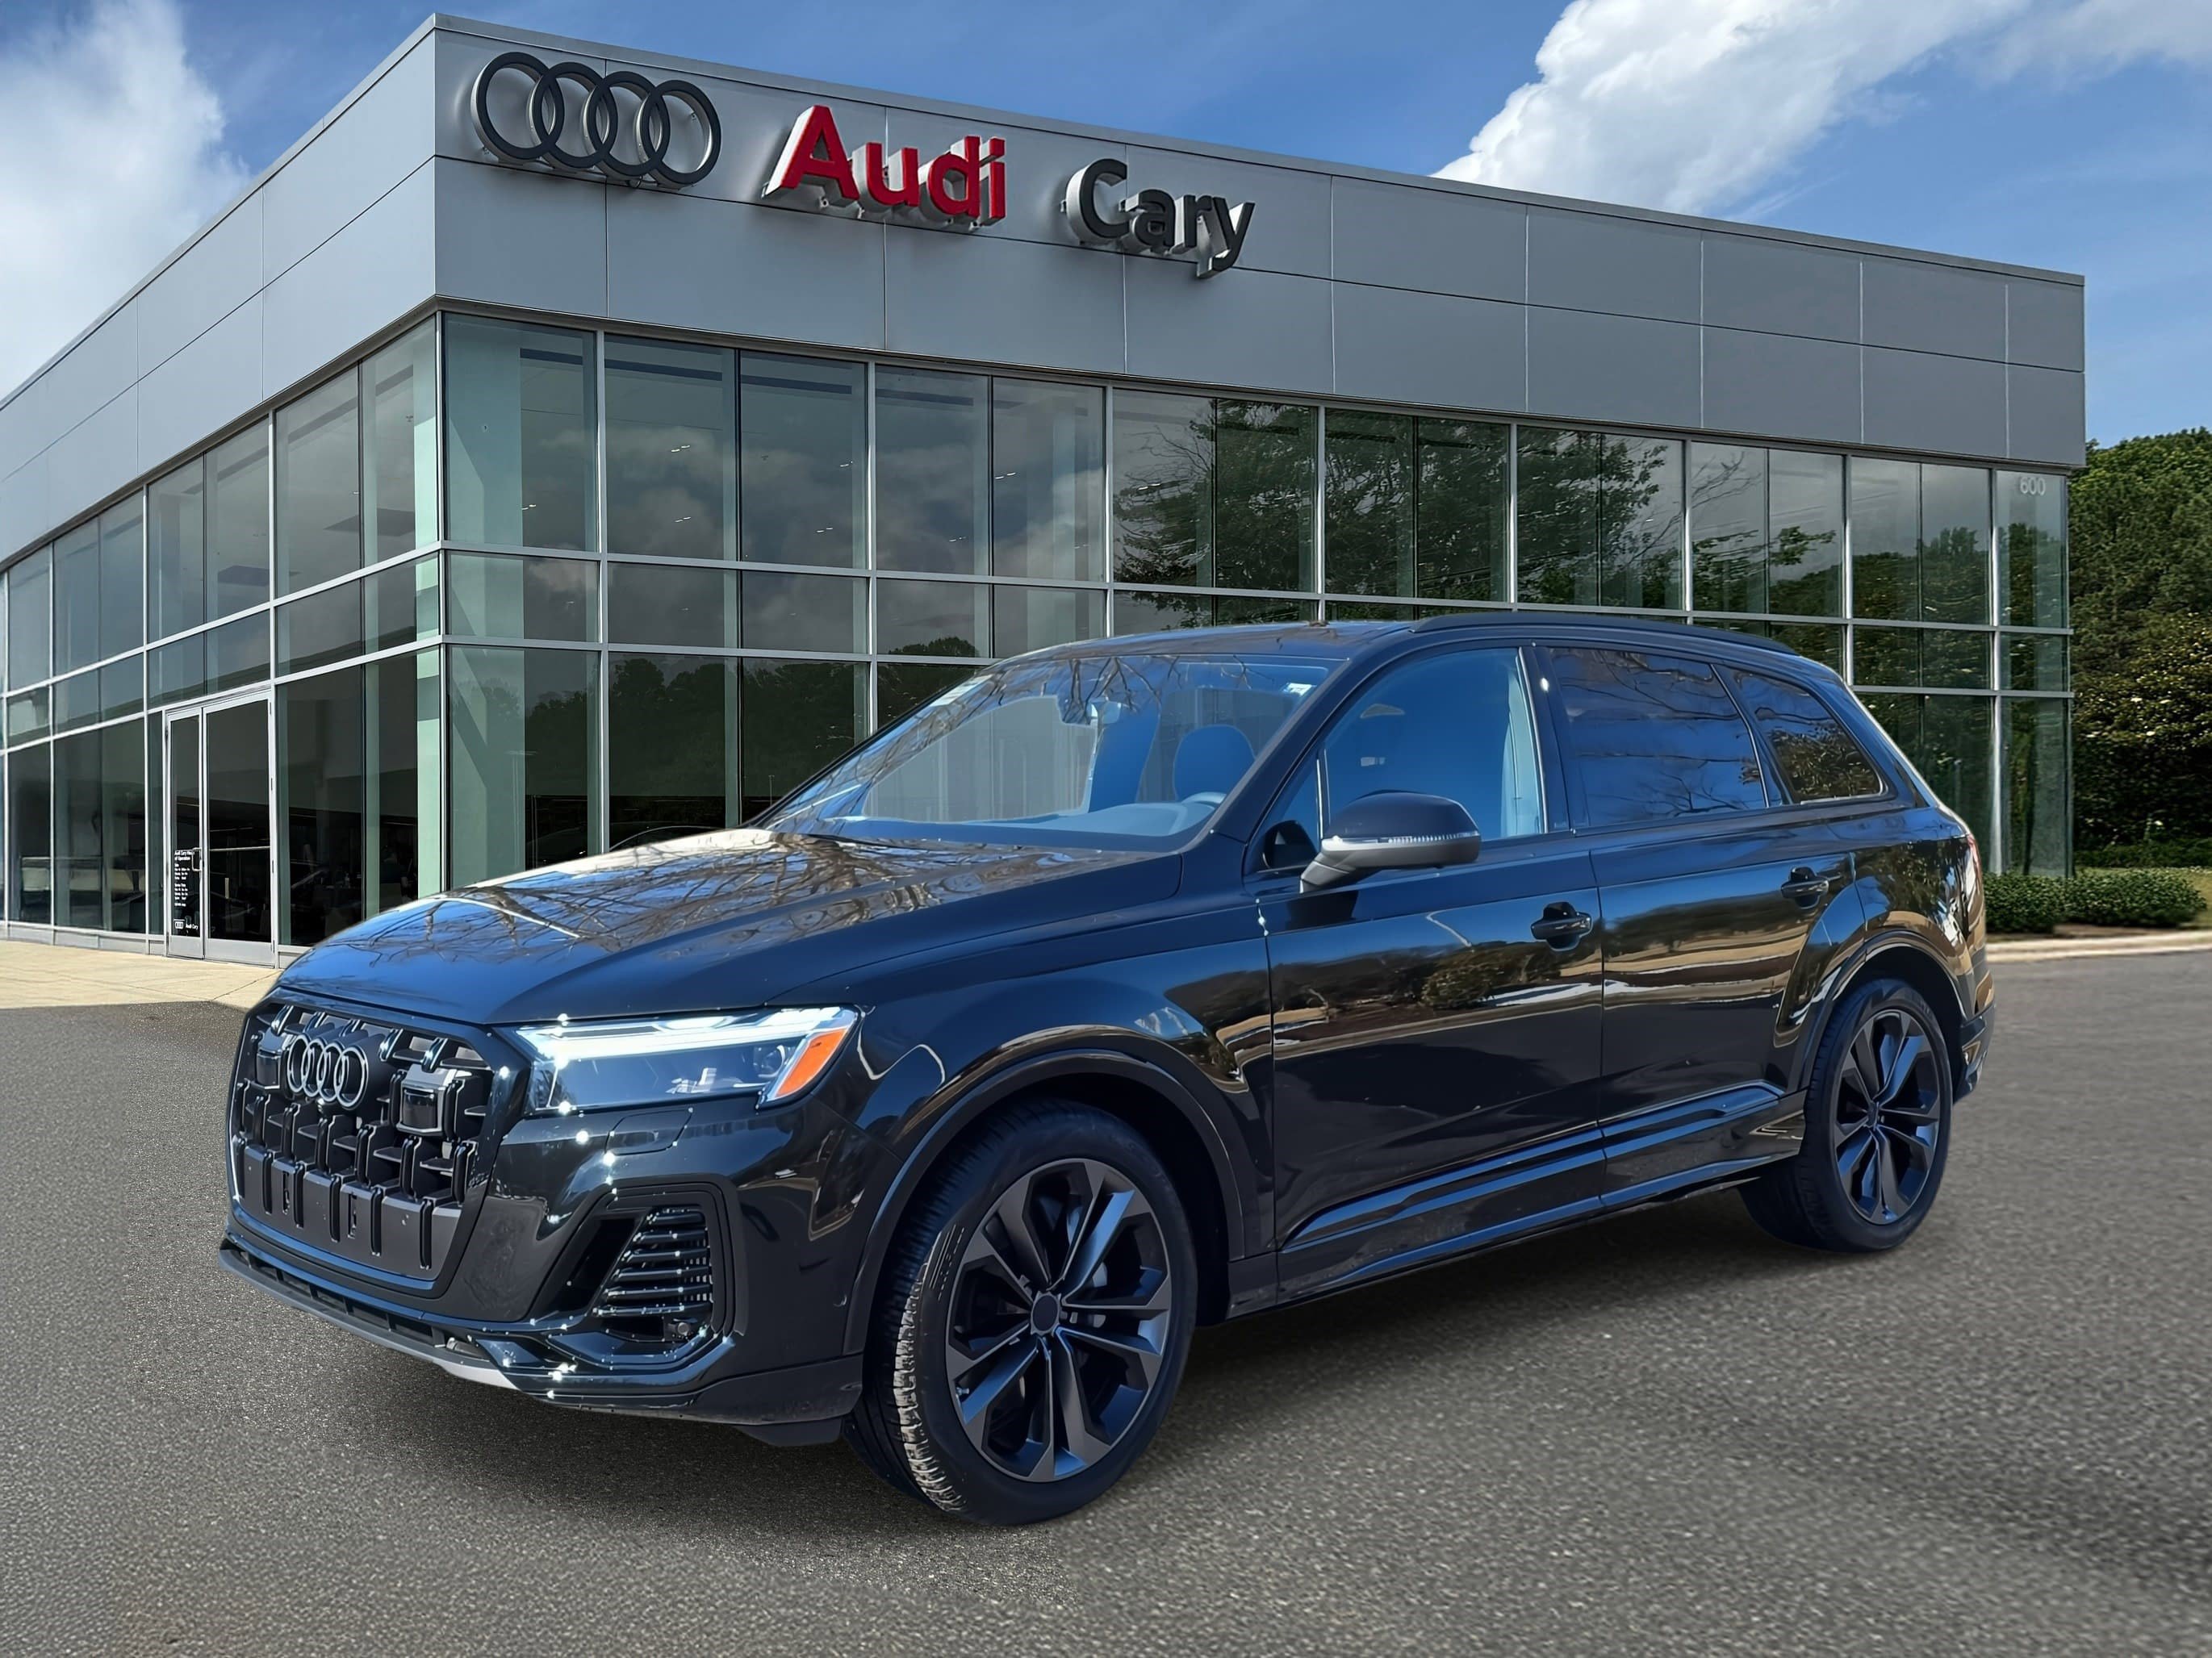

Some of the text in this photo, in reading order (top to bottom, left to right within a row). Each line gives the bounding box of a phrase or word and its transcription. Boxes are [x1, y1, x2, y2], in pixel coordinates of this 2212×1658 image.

[767, 105, 1255, 276] Audi Cary
[2020, 476, 2046, 495] 600
